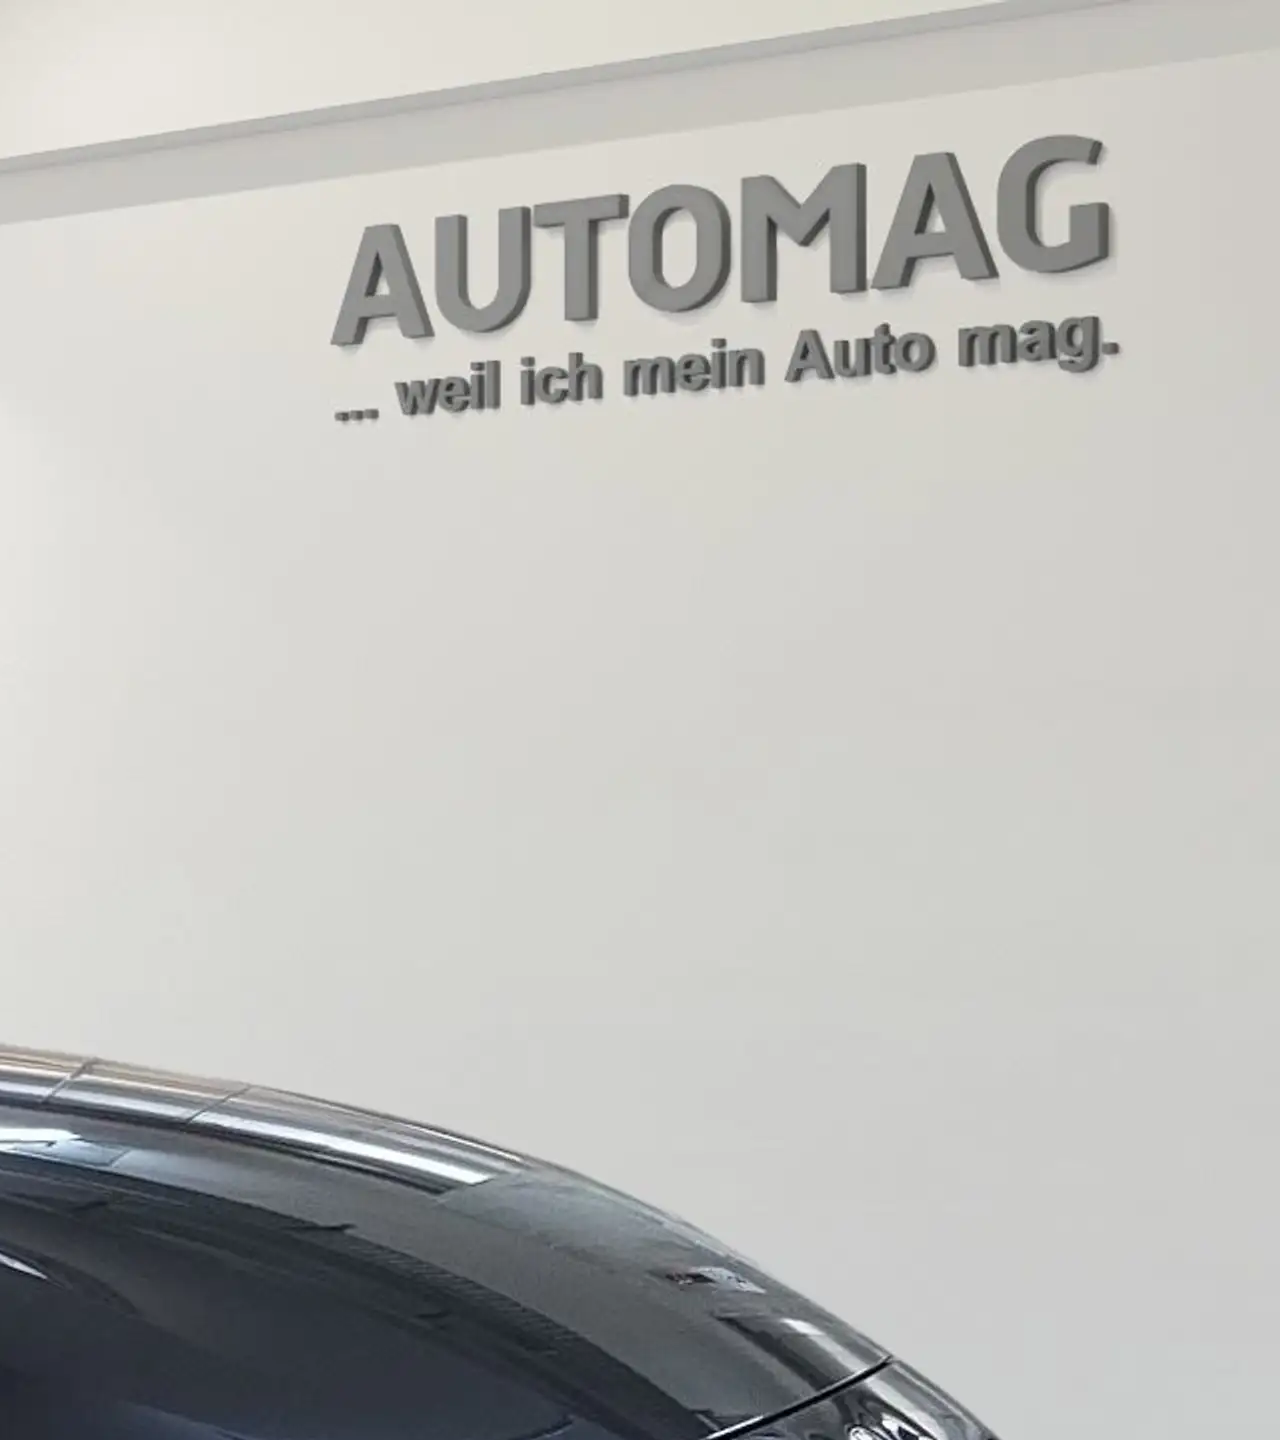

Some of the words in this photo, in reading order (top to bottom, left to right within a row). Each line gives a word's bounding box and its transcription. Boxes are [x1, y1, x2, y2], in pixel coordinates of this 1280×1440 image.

[330, 135, 1111, 346] AUTOMAG
[394, 360, 501, 416] weil
[520, 352, 604, 406] ich
[623, 338, 765, 397] mein
[784, 322, 938, 383] Auto
[957, 315, 1121, 374] mag.
